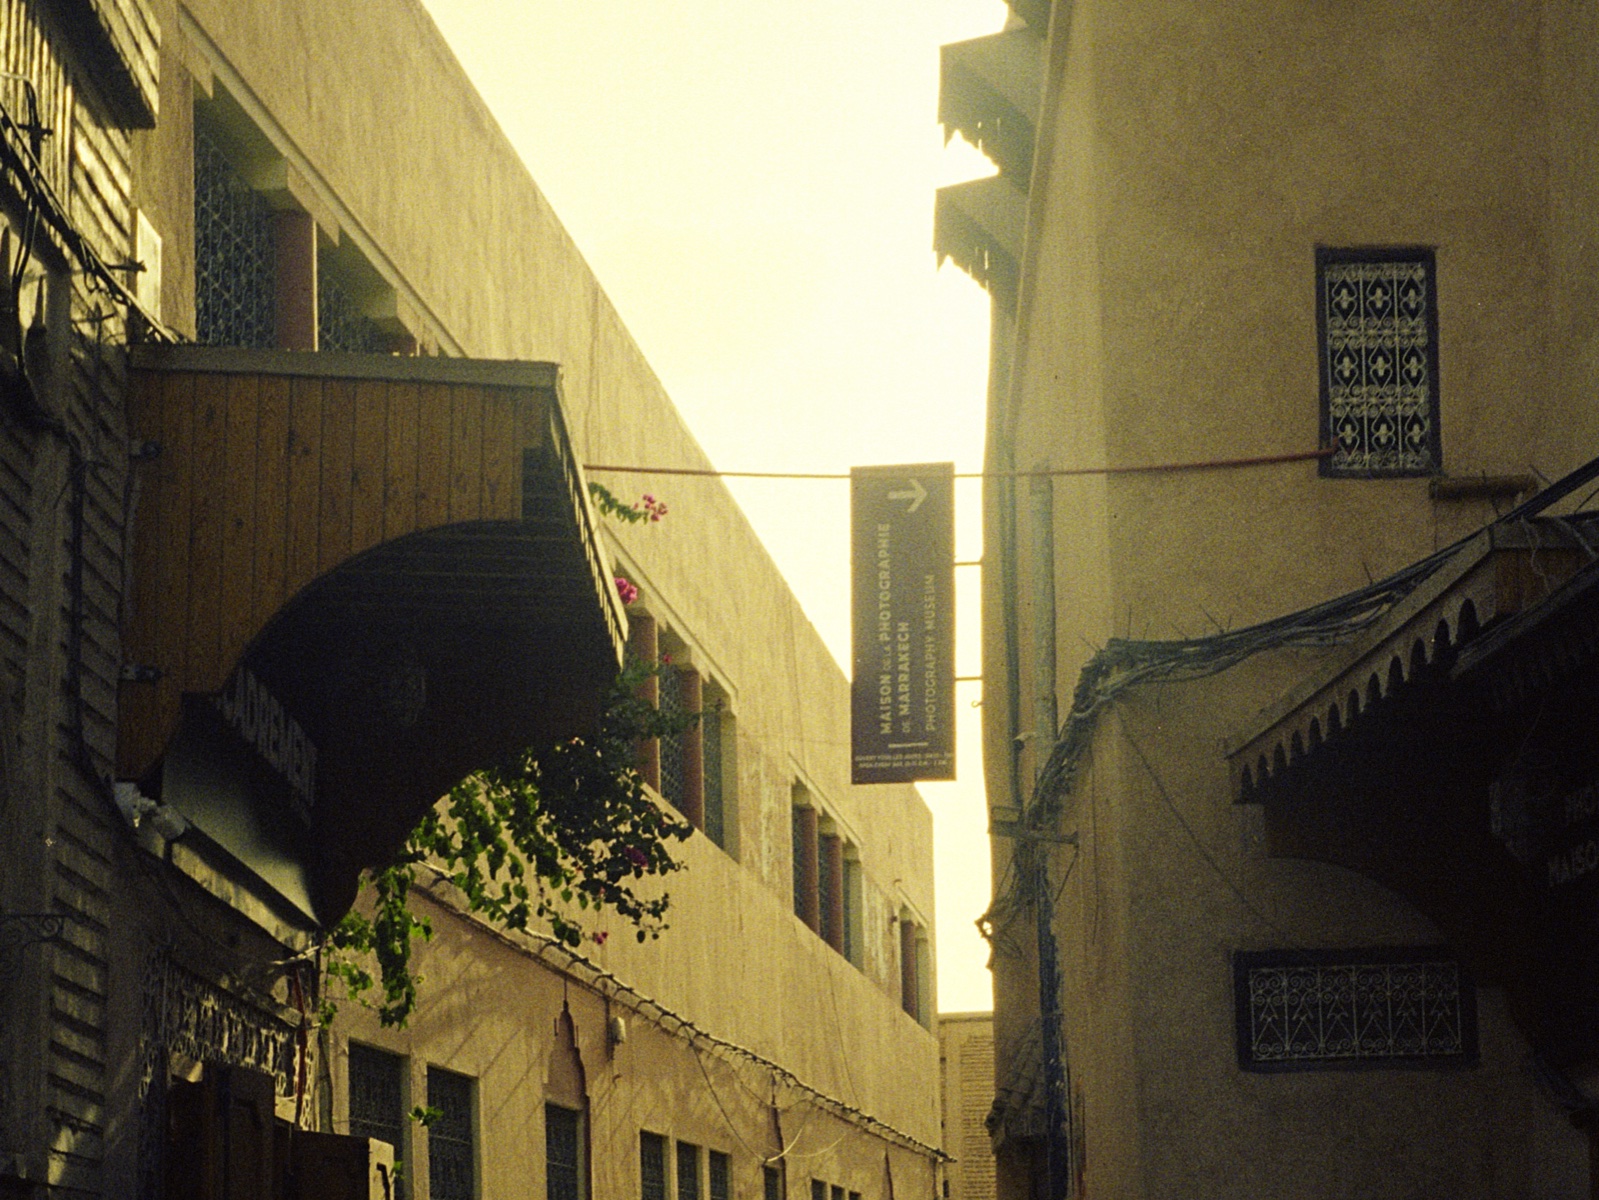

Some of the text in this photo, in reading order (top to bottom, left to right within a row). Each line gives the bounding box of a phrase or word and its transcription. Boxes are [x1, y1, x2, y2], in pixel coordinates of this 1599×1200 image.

[878, 523, 891, 641] PHOTOGRAPHIE
[879, 674, 892, 735] MAISON
[898, 621, 911, 733] DE MARRAKECH
[924, 574, 936, 731] PHOTOGRAPHY MUSEUM
[1548, 839, 1599, 887] MAISO
